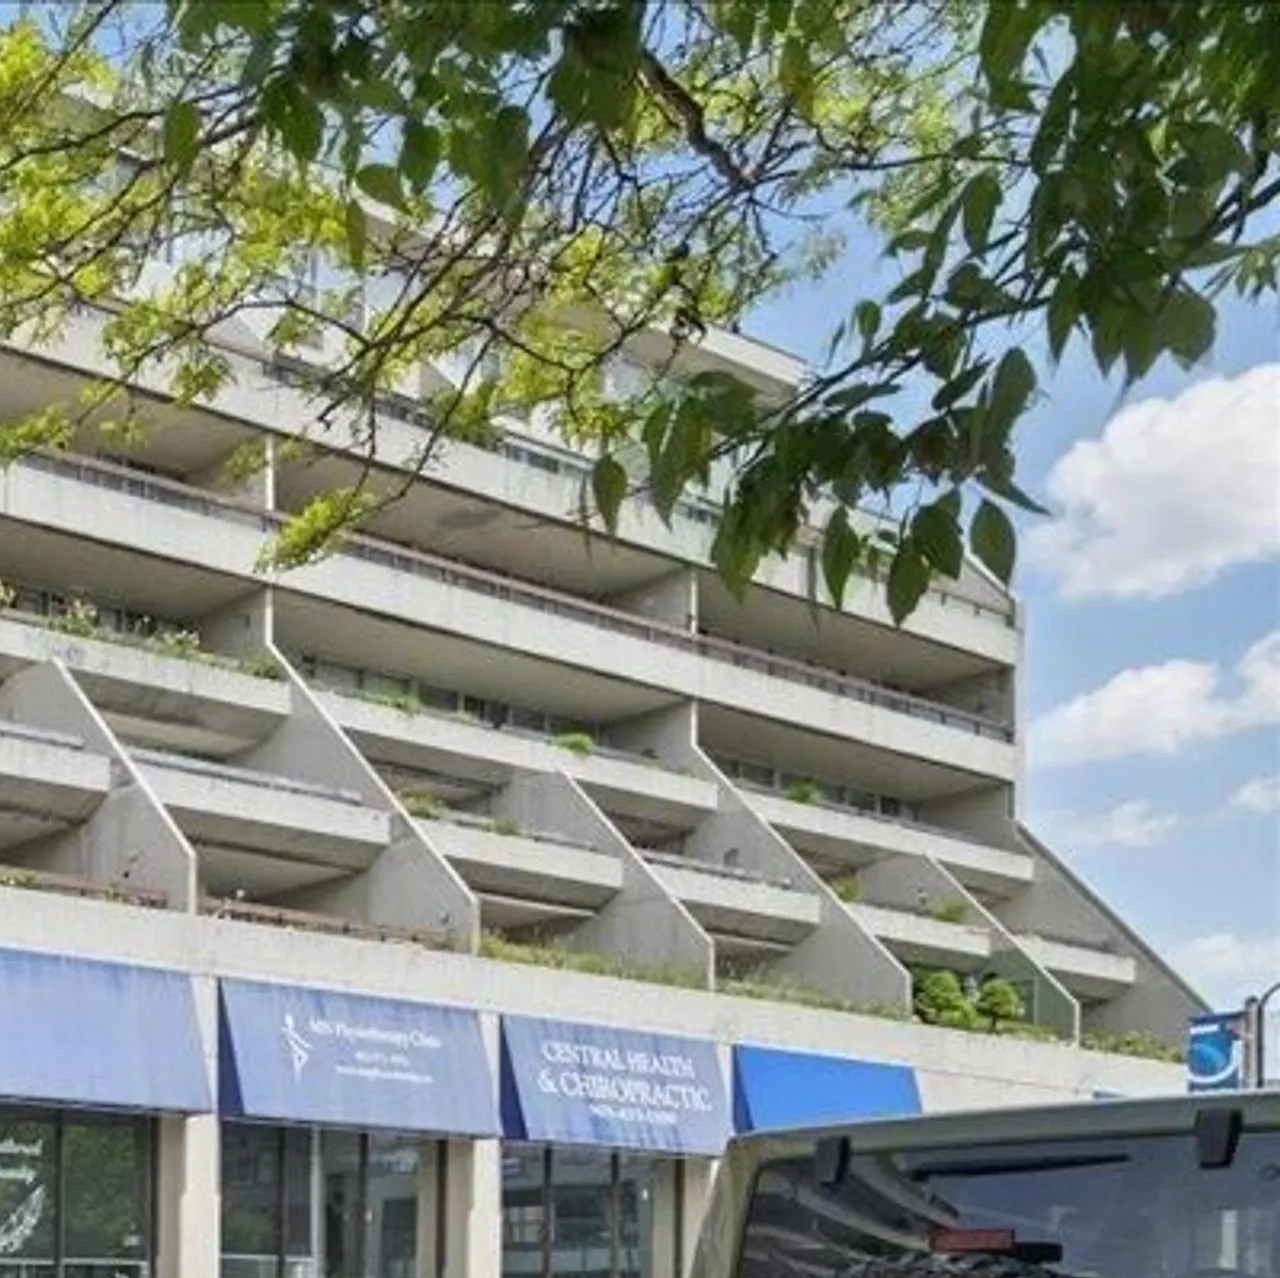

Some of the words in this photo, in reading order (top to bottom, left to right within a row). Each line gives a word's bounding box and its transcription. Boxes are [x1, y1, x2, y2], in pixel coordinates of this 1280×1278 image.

[542, 1041, 625, 1071] CENTRAL
[627, 1052, 696, 1079] HEALTH
[538, 1067, 558, 1093] &
[559, 1072, 712, 1111] CHIROPRACTIC
